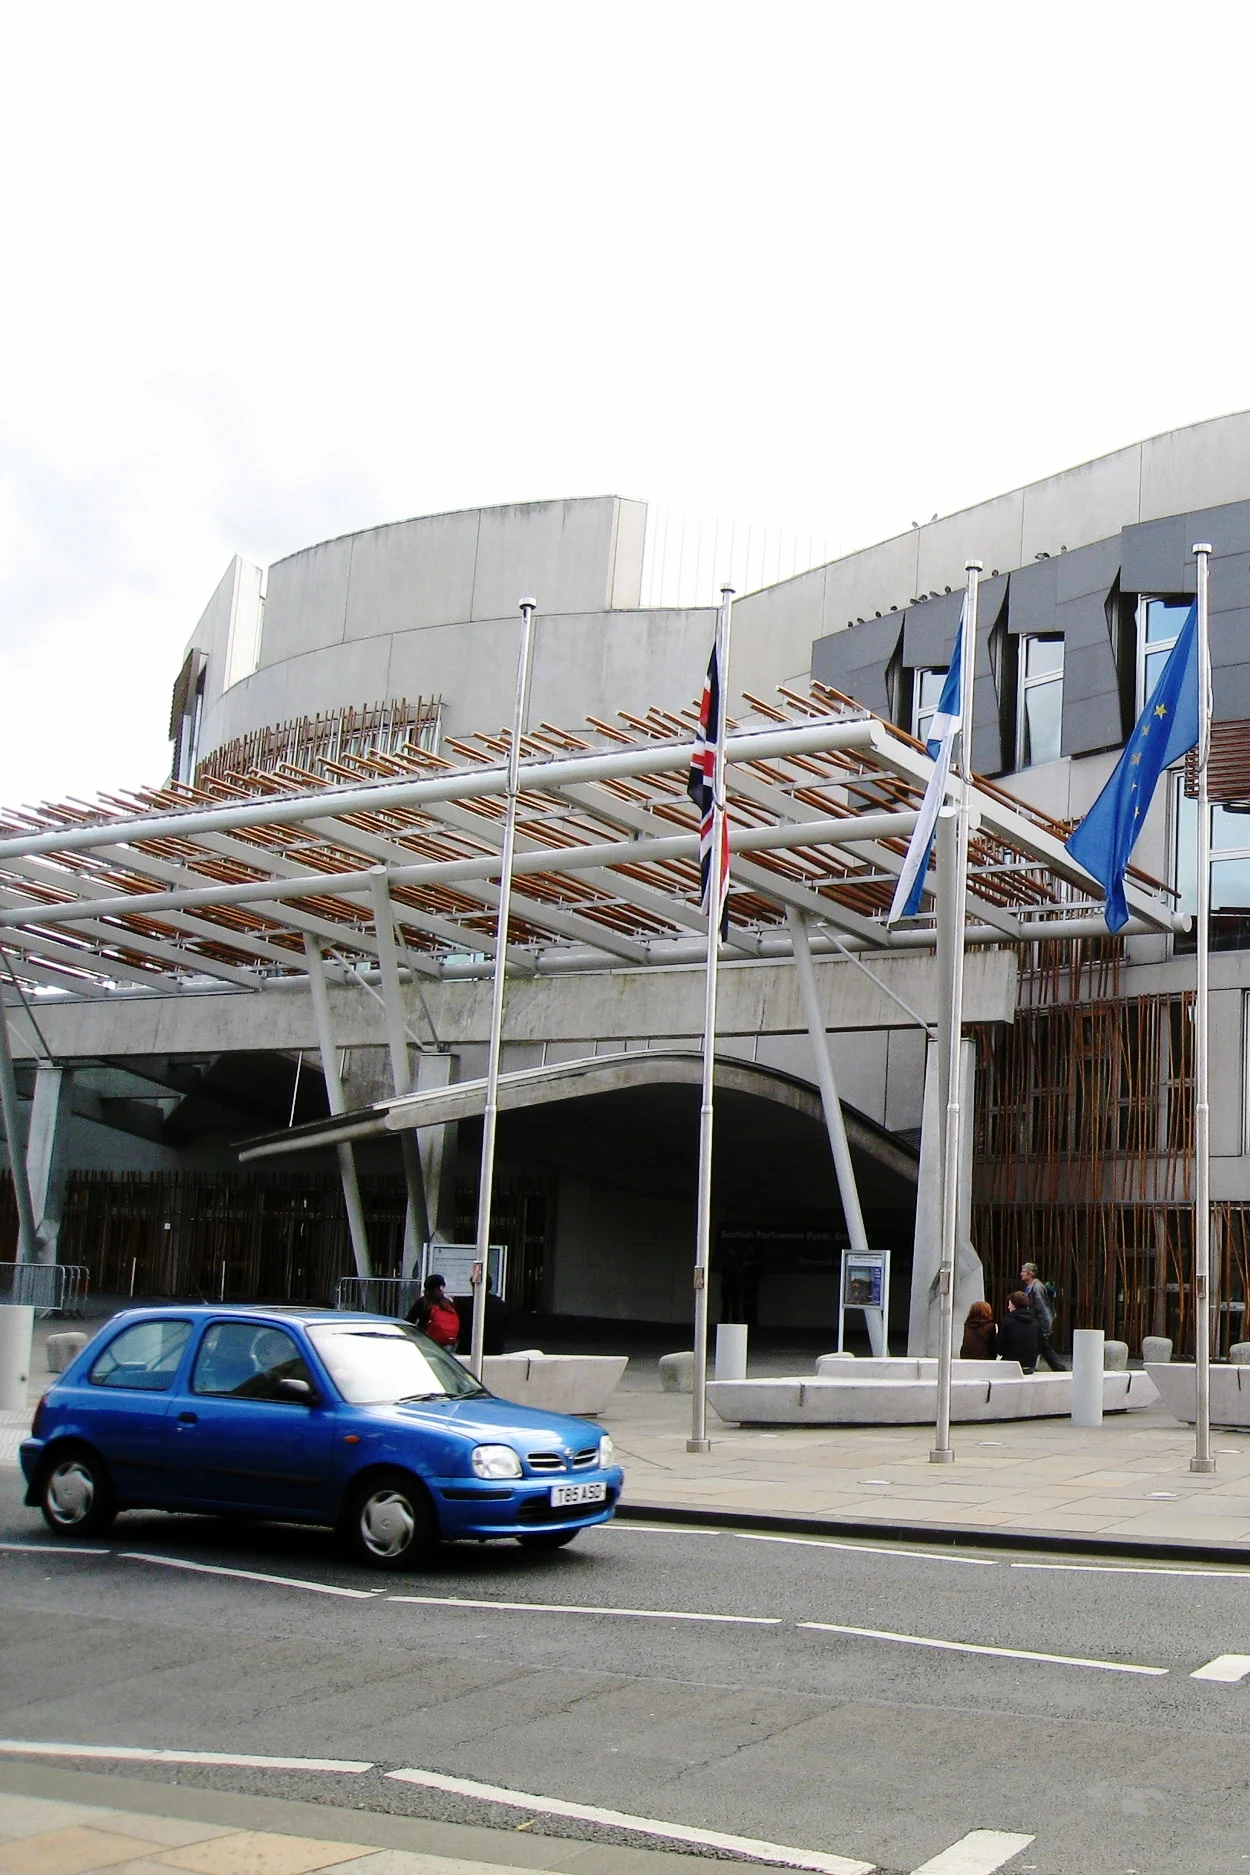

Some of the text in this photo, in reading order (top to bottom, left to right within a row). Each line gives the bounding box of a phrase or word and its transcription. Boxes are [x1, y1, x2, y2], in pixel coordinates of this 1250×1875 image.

[721, 1230, 754, 1239] Scottish
[757, 1231, 804, 1240] Parliament
[807, 1232, 832, 1241] Public
[558, 1483, 602, 1504] T85 ASD
